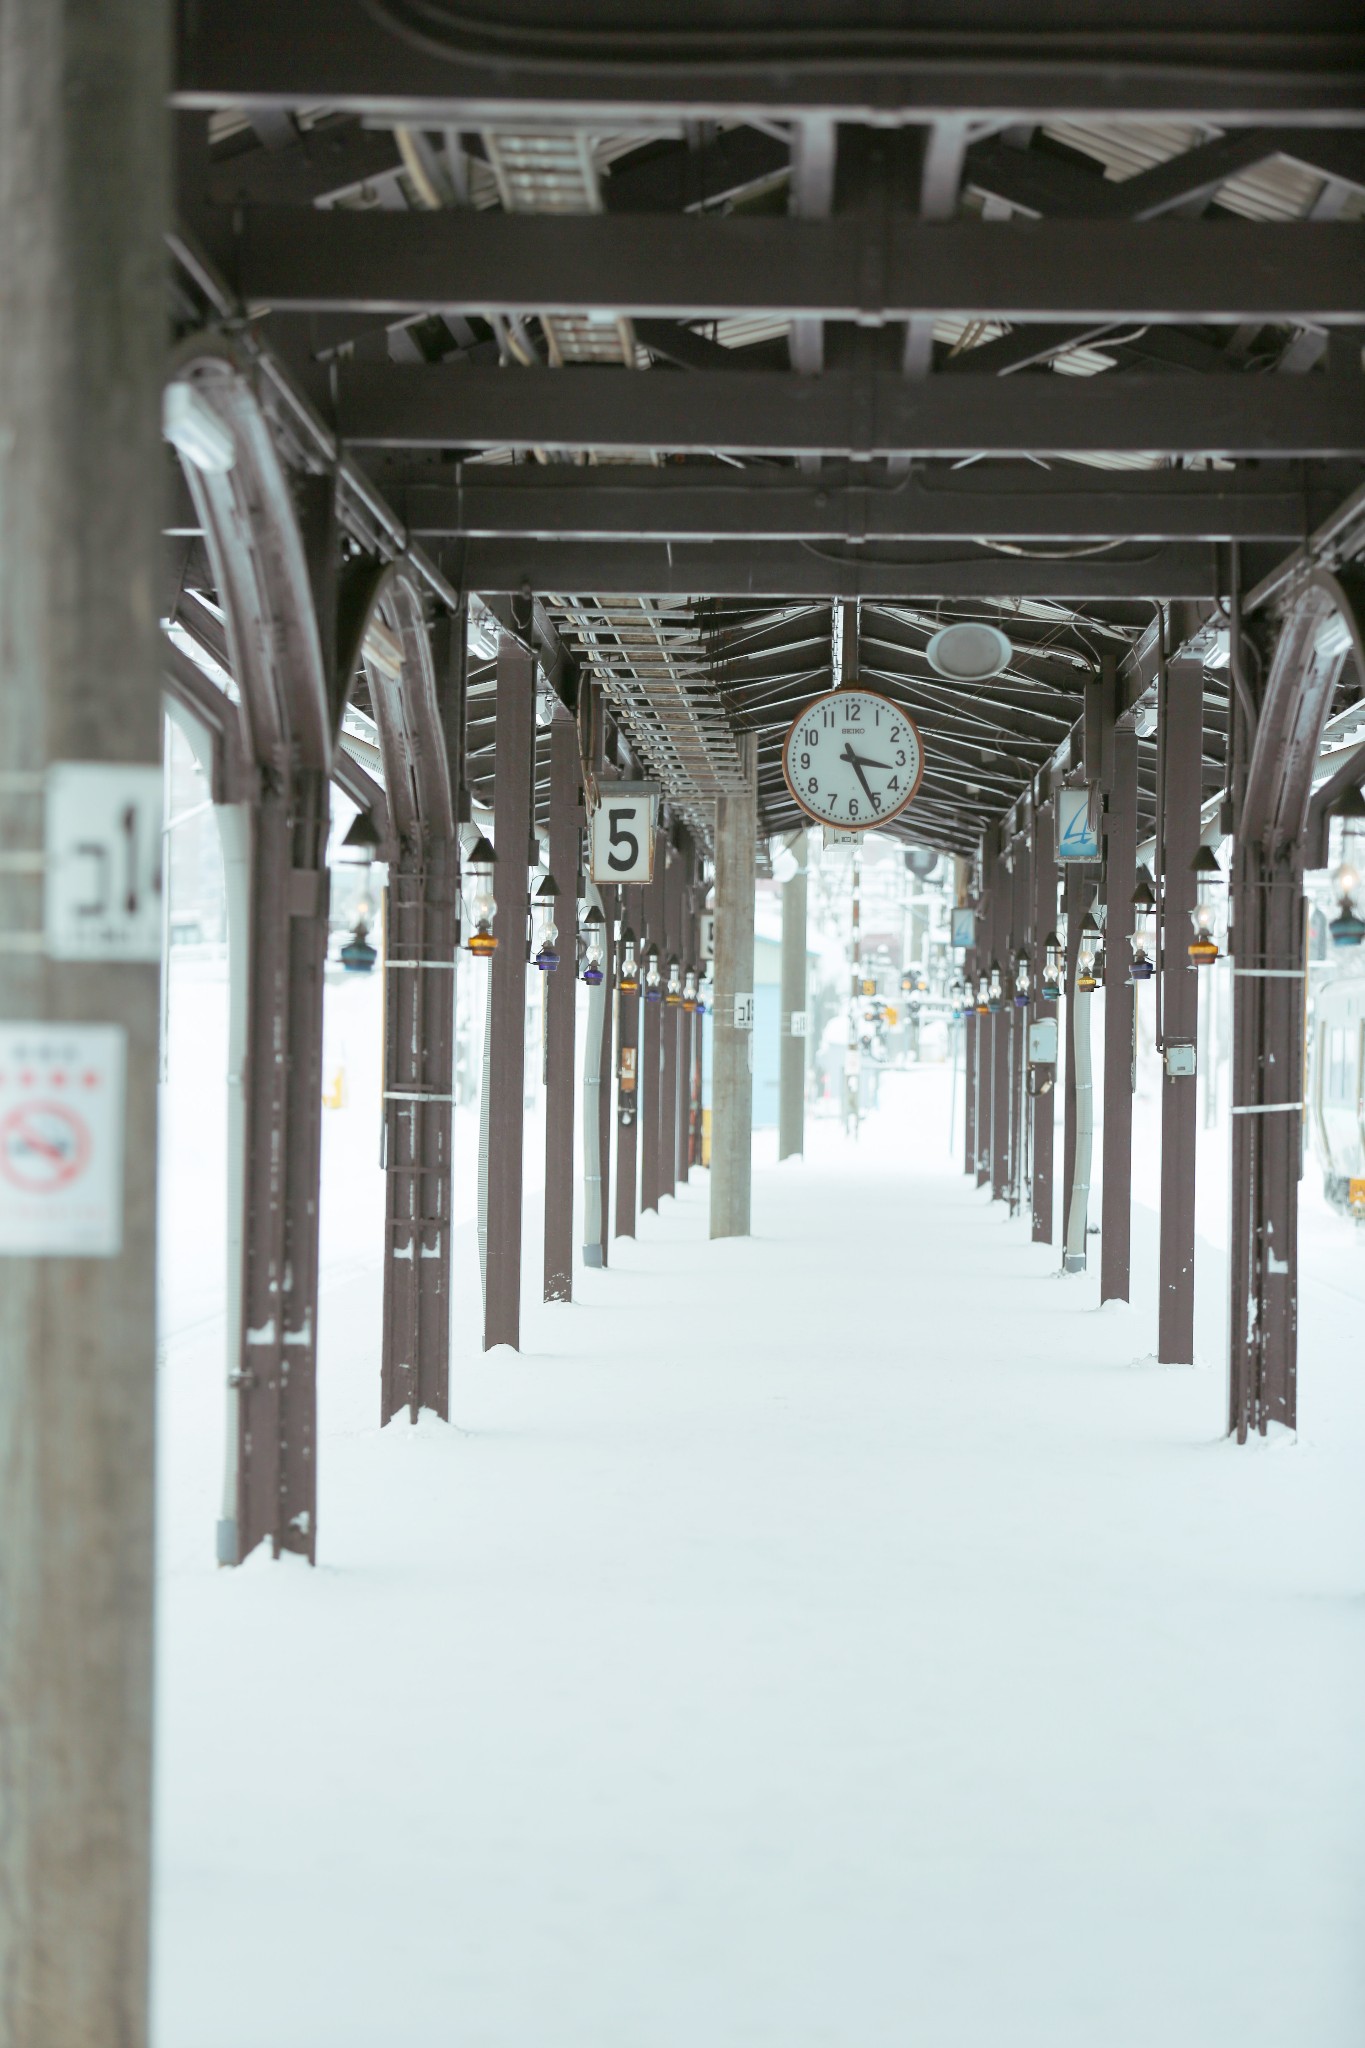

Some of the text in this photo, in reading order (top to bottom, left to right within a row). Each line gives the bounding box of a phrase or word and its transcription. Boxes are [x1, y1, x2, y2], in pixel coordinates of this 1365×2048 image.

[823, 711, 835, 728] 11
[845, 704, 861, 721] 12
[875, 709, 879, 727] 1
[804, 729, 819, 747] 10
[889, 726, 900, 743] 2
[800, 752, 811, 770] 9
[895, 750, 907, 767] 3
[807, 777, 819, 794] 8
[886, 774, 900, 792] 4
[827, 793, 838, 810] 7
[848, 799, 859, 816] 6
[870, 792, 882, 809] 5
[607, 808, 639, 872] 5
